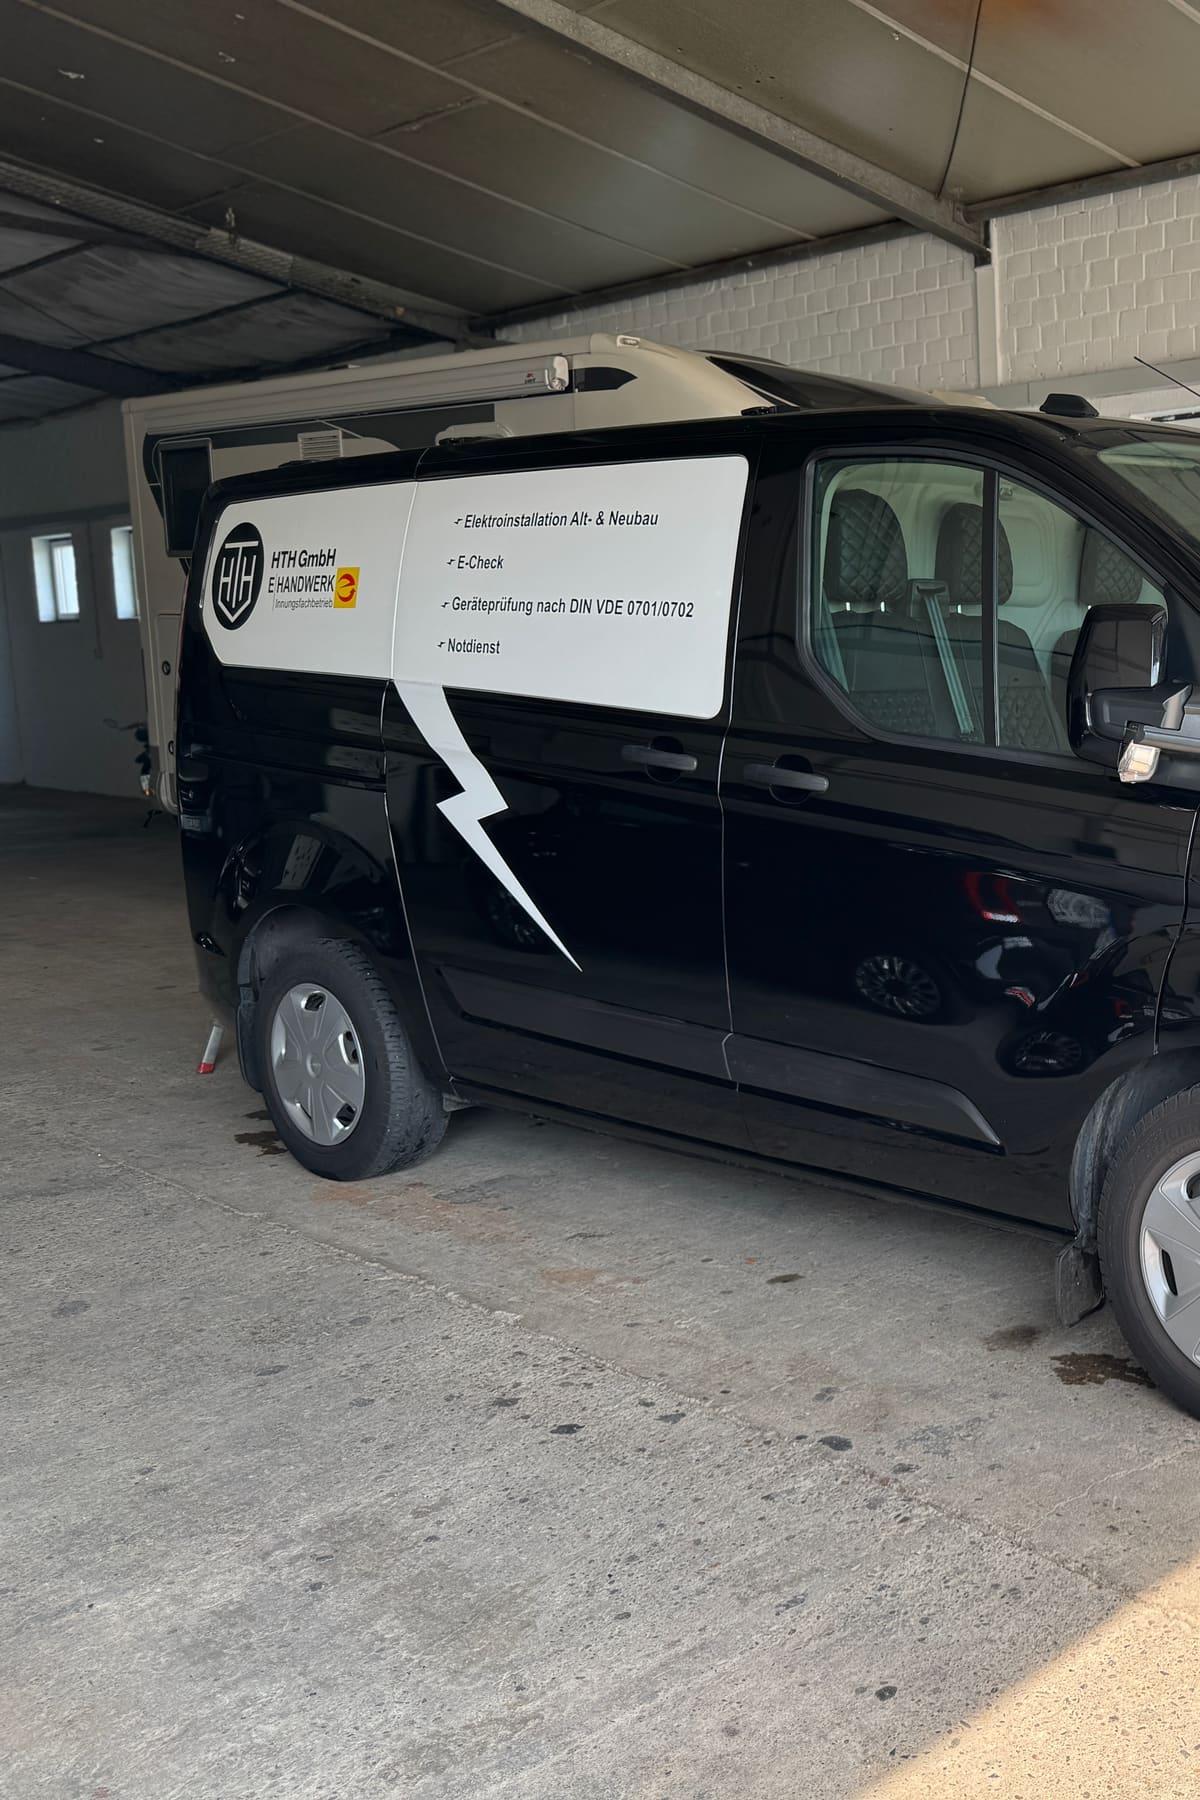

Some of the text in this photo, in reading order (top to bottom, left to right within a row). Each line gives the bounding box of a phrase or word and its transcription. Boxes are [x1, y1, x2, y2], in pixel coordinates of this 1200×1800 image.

[464, 510, 658, 528] Elektroinstallation Alt- & Neubau
[271, 548, 336, 570] HTH GmbH
[456, 555, 504, 569] E-Check
[218, 540, 259, 622] HTH
[268, 574, 335, 594] E HANDWERK
[275, 597, 333, 611] Innungsfachbetrieb
[450, 596, 694, 617] Geräteprüfung nach DIN VDE 0701/0702
[446, 638, 500, 655] Notdienst
